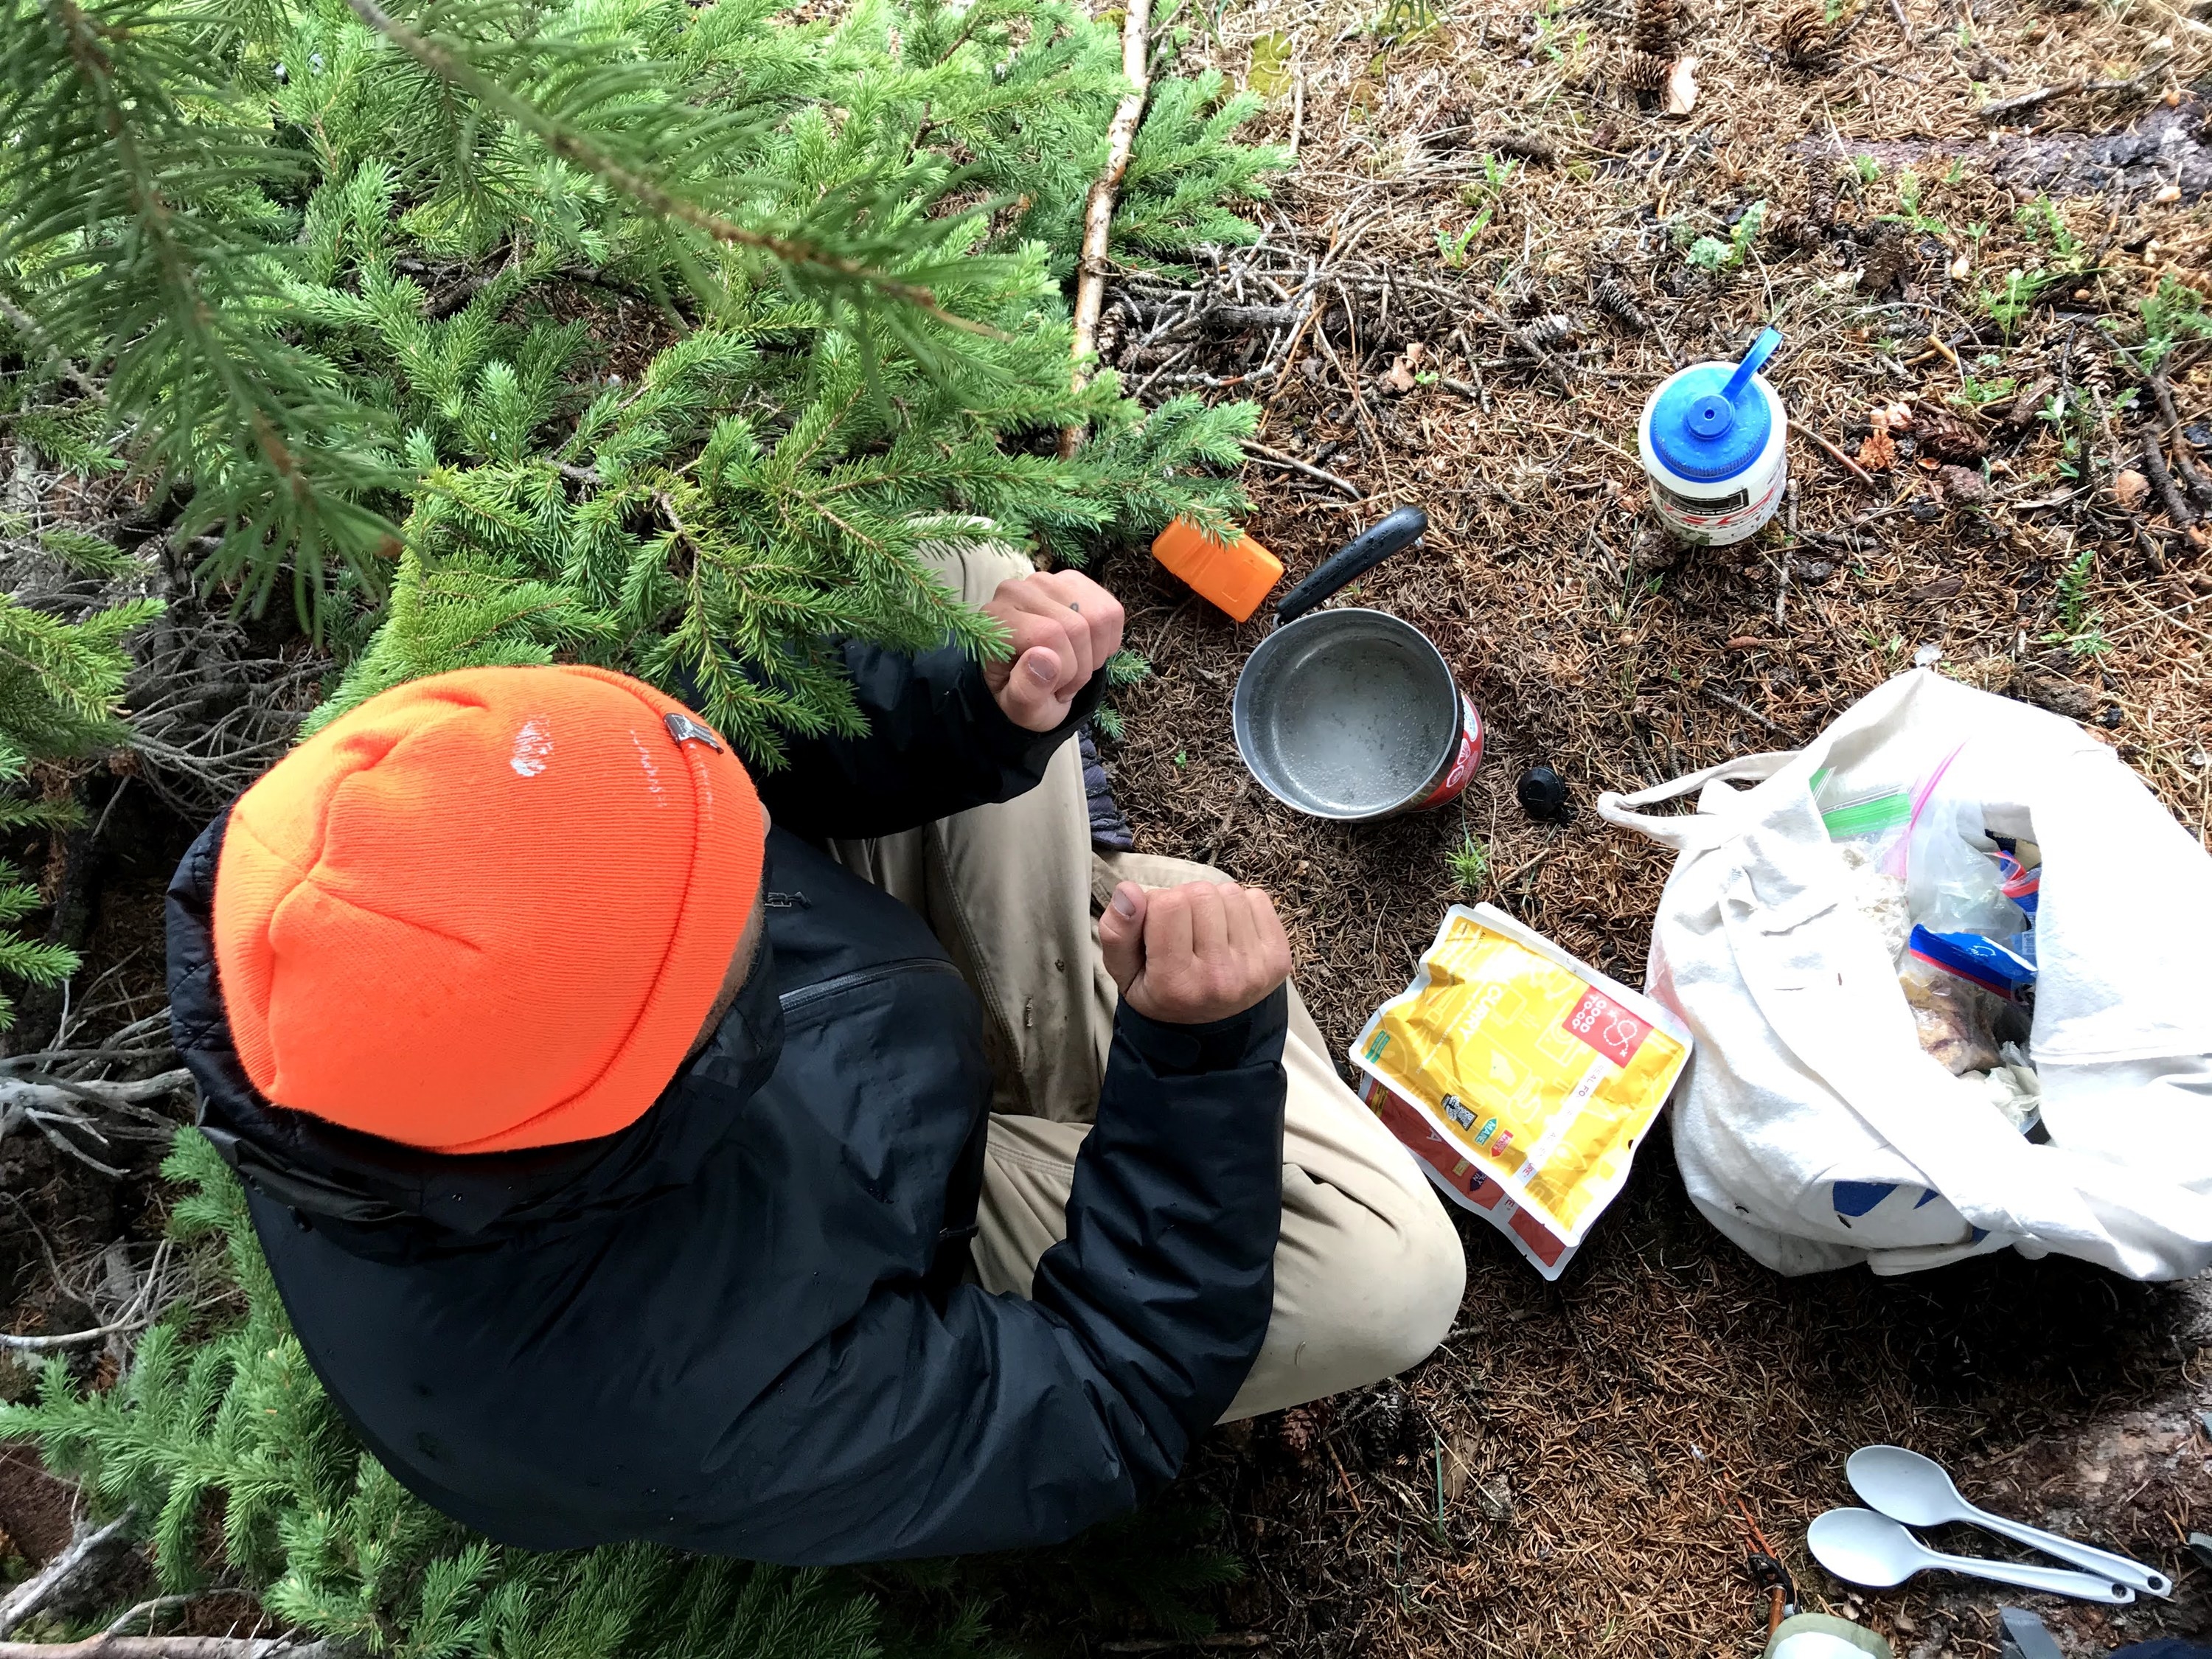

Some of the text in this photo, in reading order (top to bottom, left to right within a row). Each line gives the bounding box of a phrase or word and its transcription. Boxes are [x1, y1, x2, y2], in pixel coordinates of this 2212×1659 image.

[1459, 987, 1501, 1041] CURRY
[1571, 995, 1599, 1026] TO-GO
[1579, 999, 1607, 1032] GOOD
